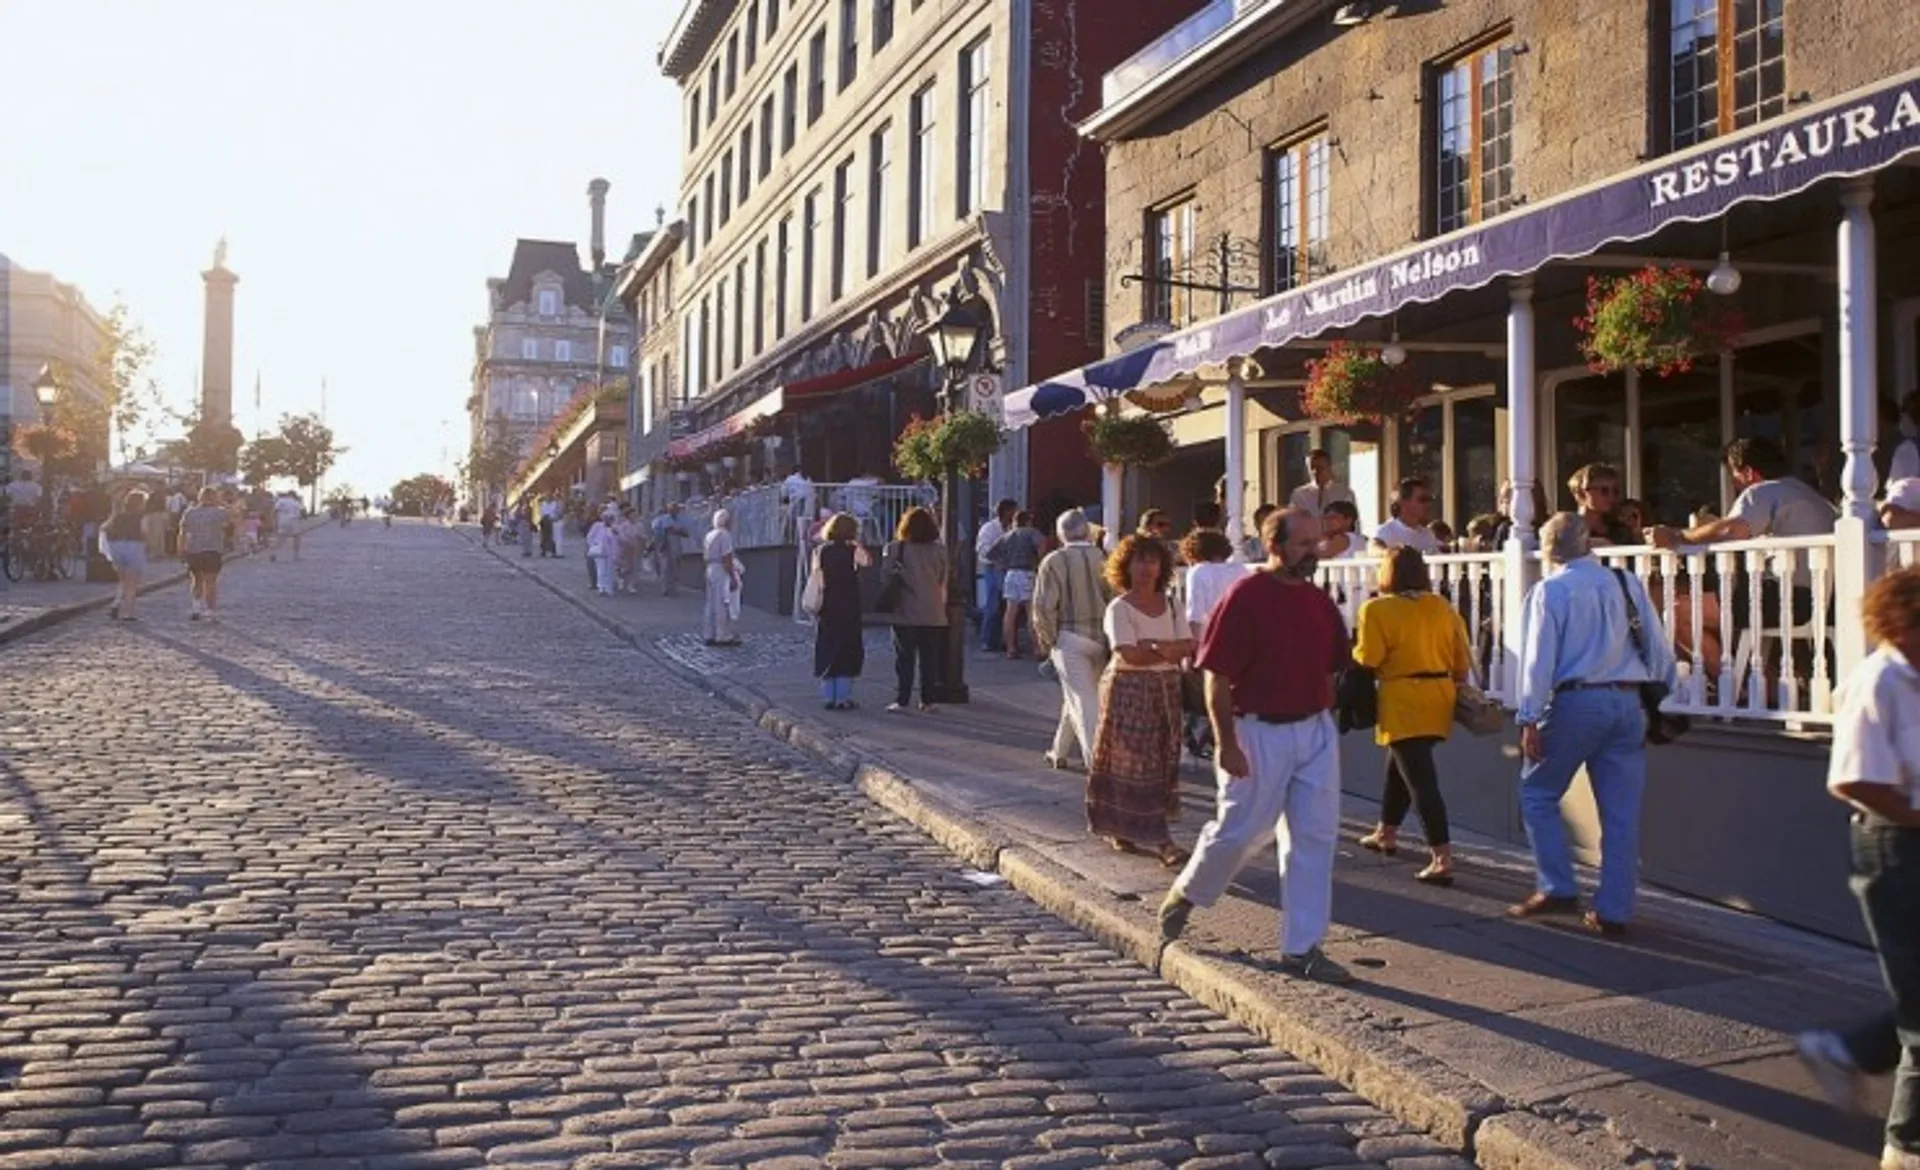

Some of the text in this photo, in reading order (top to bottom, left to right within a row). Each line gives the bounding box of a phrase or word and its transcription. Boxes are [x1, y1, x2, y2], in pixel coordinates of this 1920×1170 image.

[1650, 91, 1920, 207] RESTAURA
[1266, 243, 1480, 331] Le Jardin Nelson
